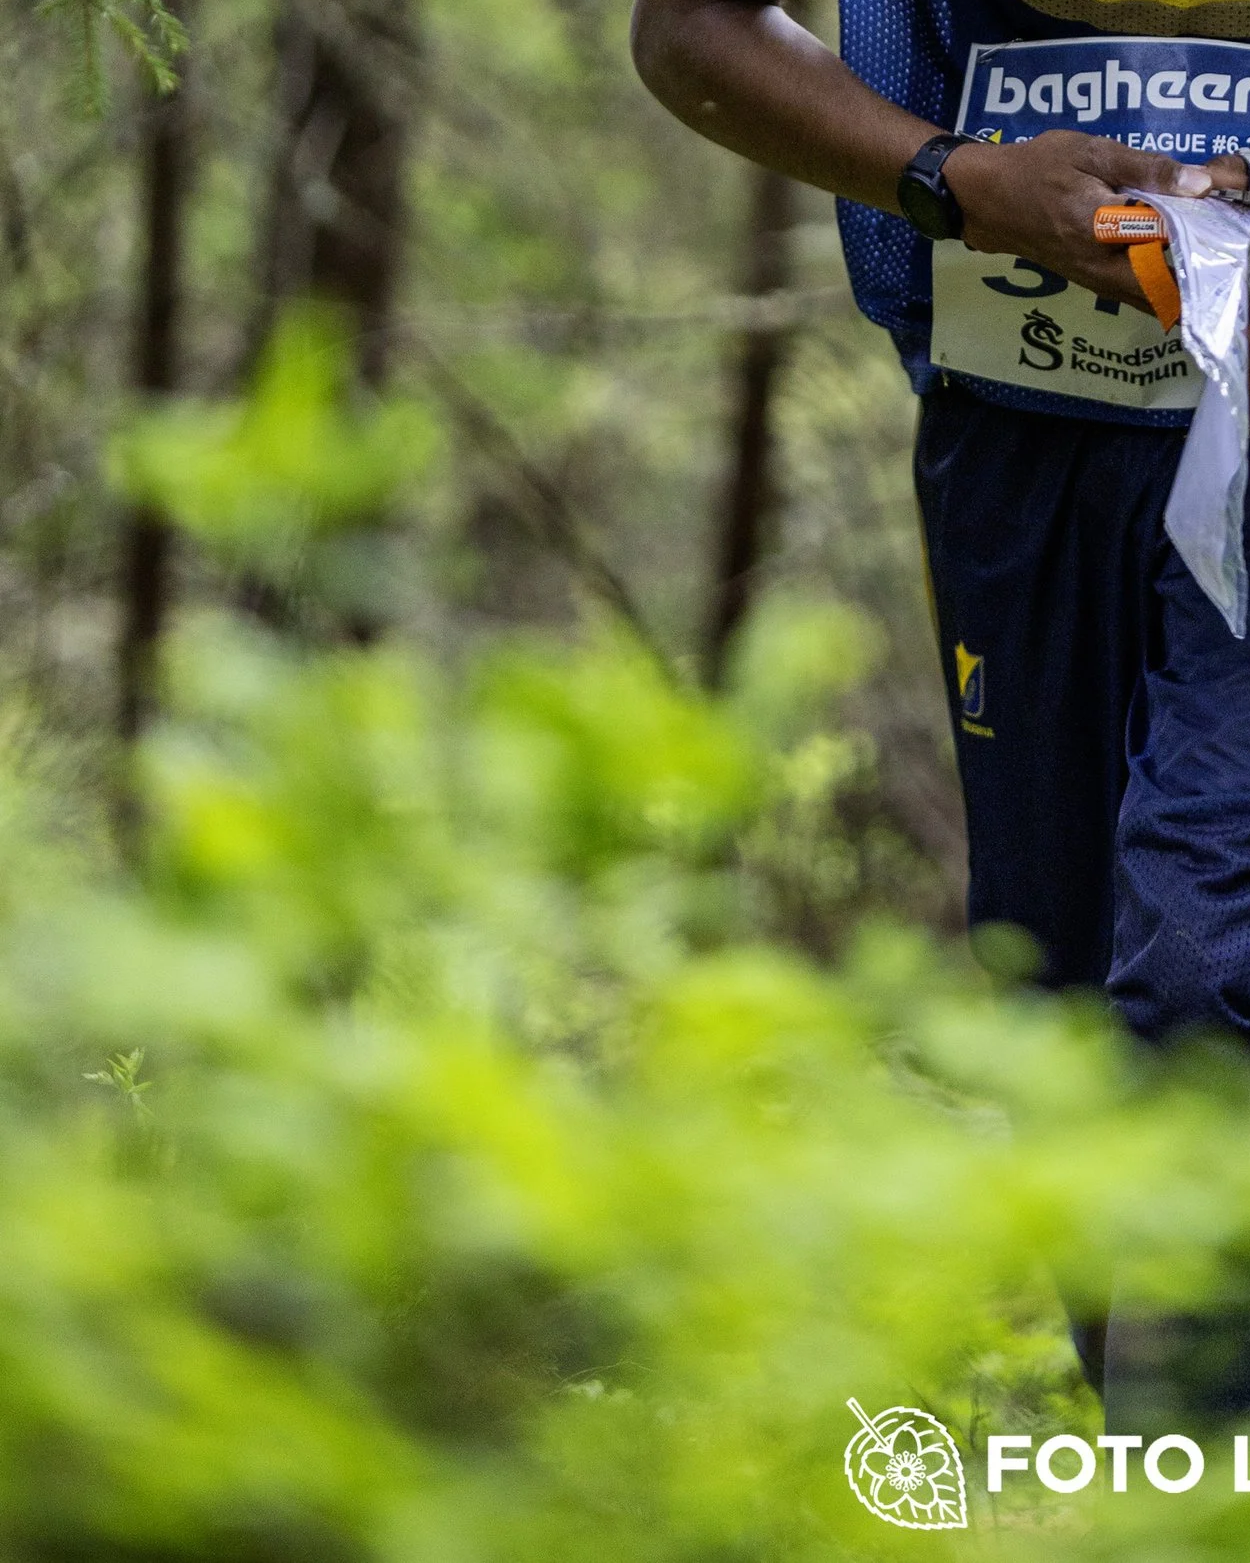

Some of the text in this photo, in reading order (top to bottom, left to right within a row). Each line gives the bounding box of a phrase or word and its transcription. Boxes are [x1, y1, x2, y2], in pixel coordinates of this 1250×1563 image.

[1212, 134, 1239, 154] #6
[1071, 336, 1183, 367] Sundsva
[1071, 353, 1188, 386] kommun
